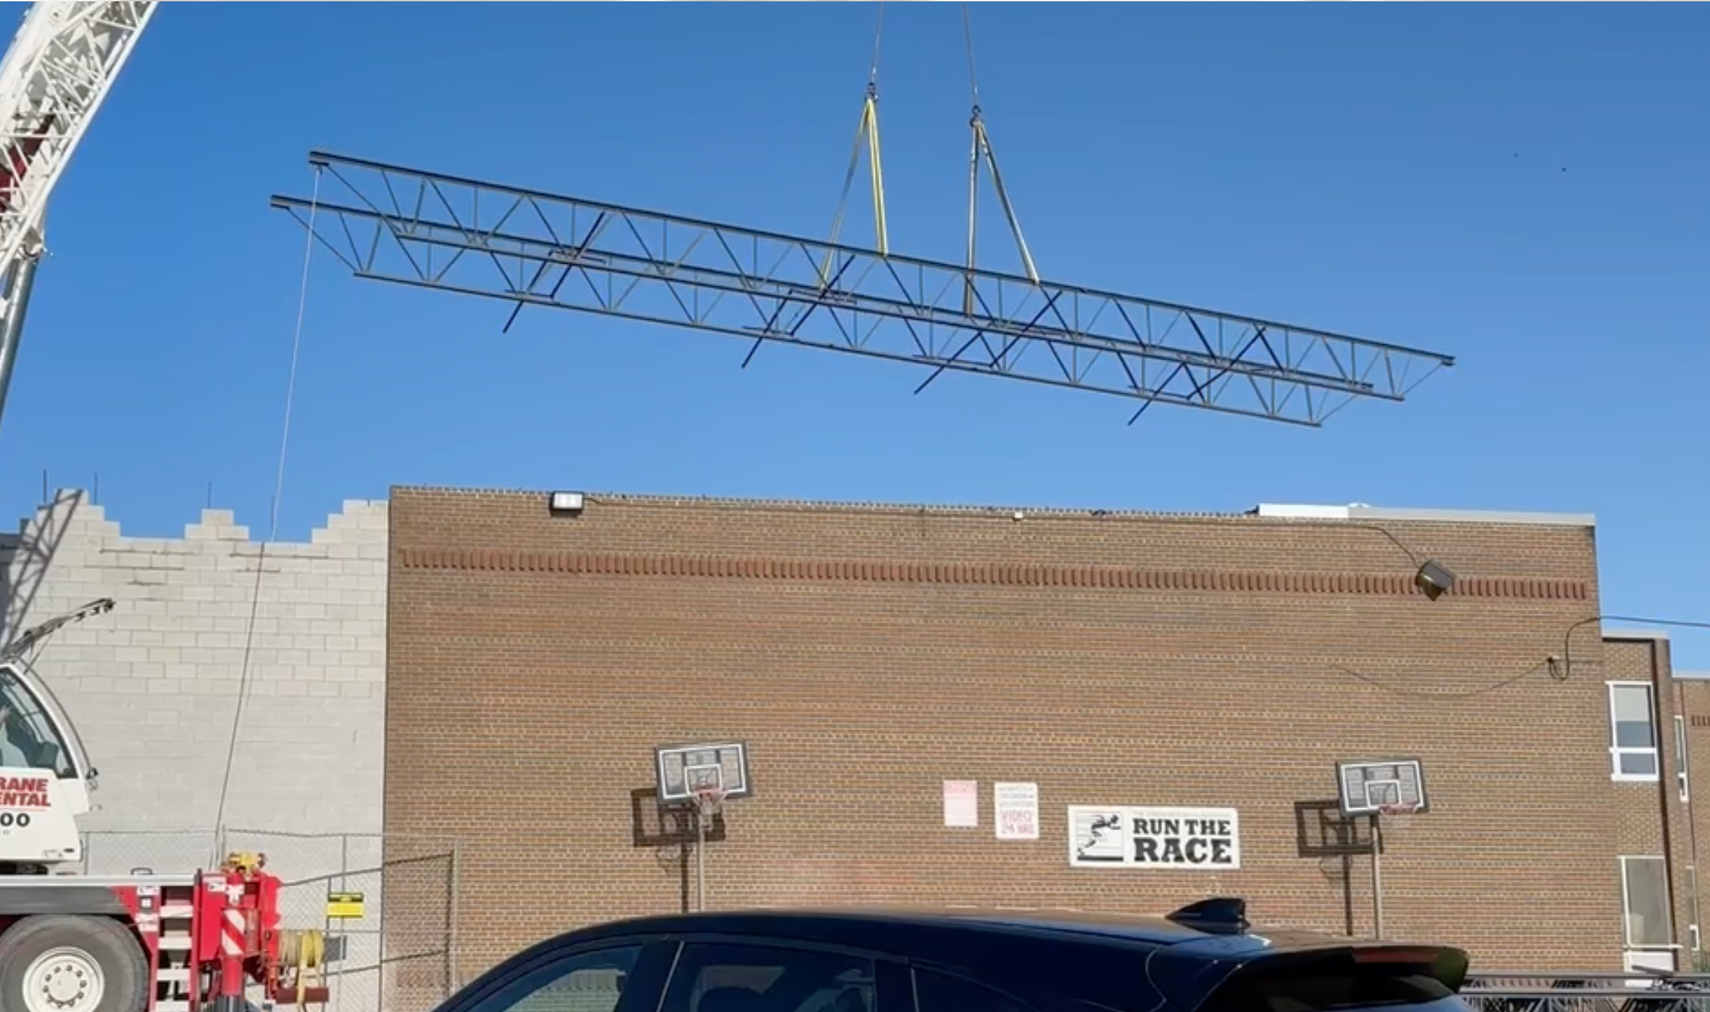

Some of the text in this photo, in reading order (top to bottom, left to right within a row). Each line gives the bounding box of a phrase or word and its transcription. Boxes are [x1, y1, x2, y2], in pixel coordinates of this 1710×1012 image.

[0, 792, 51, 807] NTAL
[1133, 818, 1231, 836] RUN THE
[1133, 837, 1232, 864] RACE
